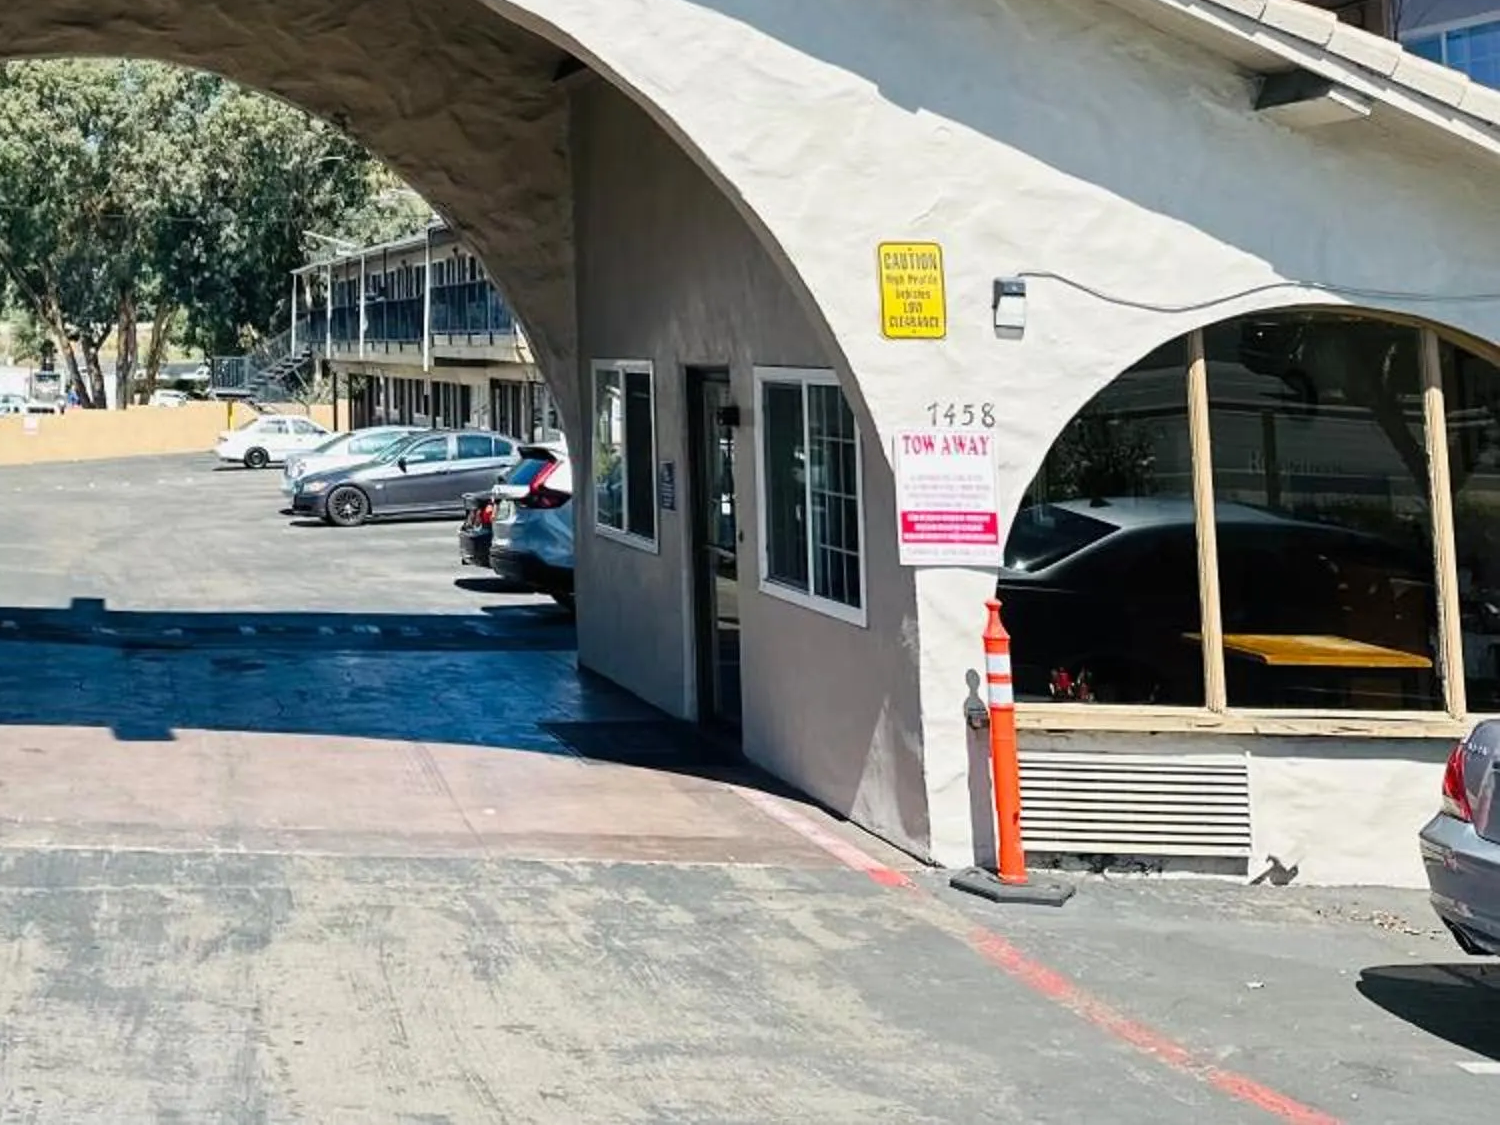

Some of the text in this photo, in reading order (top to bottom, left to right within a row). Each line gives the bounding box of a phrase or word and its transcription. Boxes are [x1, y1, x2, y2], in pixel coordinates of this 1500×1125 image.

[884, 252, 937, 271] CAUTION
[888, 315, 939, 328] CLEARANCE
[903, 435, 990, 456] TOW AWAY
